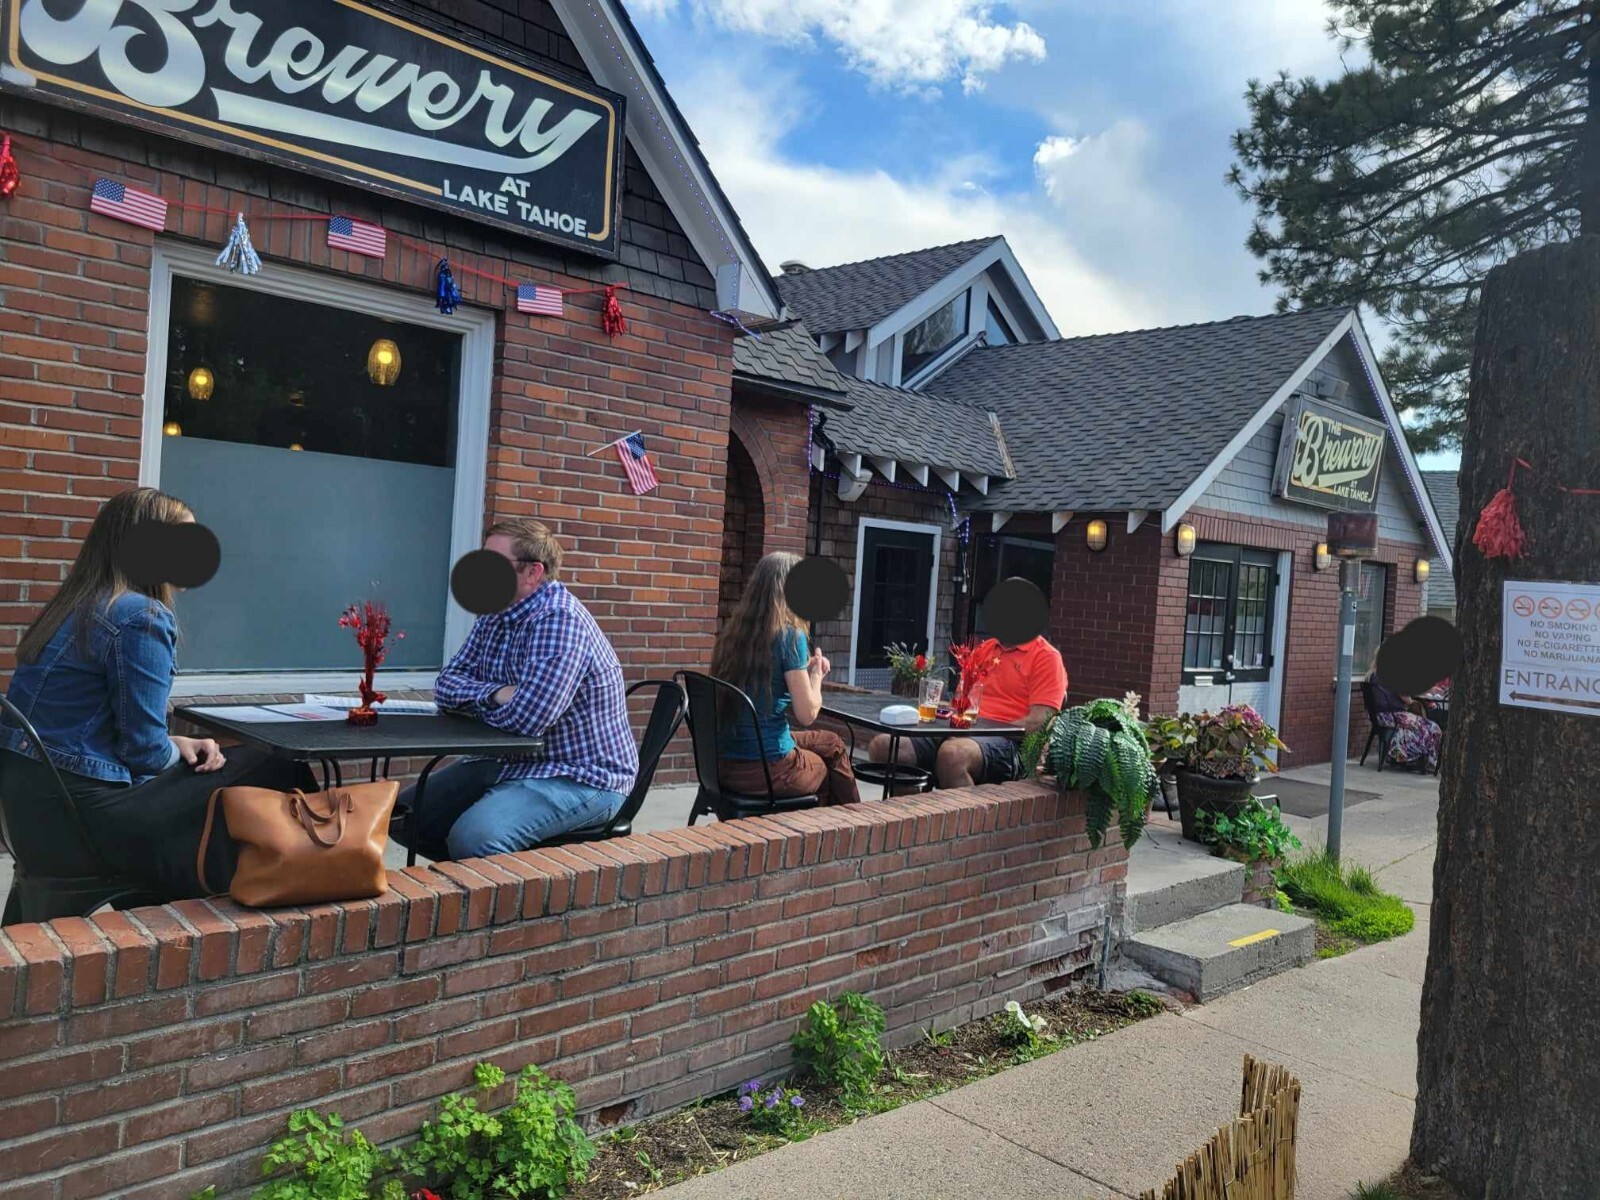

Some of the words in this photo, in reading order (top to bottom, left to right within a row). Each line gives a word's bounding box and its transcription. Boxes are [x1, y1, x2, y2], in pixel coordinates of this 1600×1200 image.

[500, 176, 530, 198] AT
[443, 179, 508, 215] LAKE
[517, 201, 587, 238] TAHOE
[1327, 422, 1341, 436] THE
[1293, 416, 1384, 488] Brewery
[1333, 484, 1349, 497] LAKE
[1351, 488, 1369, 502] TAHOE
[1530, 620, 1544, 628] NO
[1547, 621, 1598, 632] SMOKING
[1518, 639, 1531, 647] NO
[1535, 631, 1549, 639] NO
[1552, 632, 1592, 642] VAPING
[1524, 649, 1538, 657] NO
[1541, 652, 1600, 664] MARIJUANA
